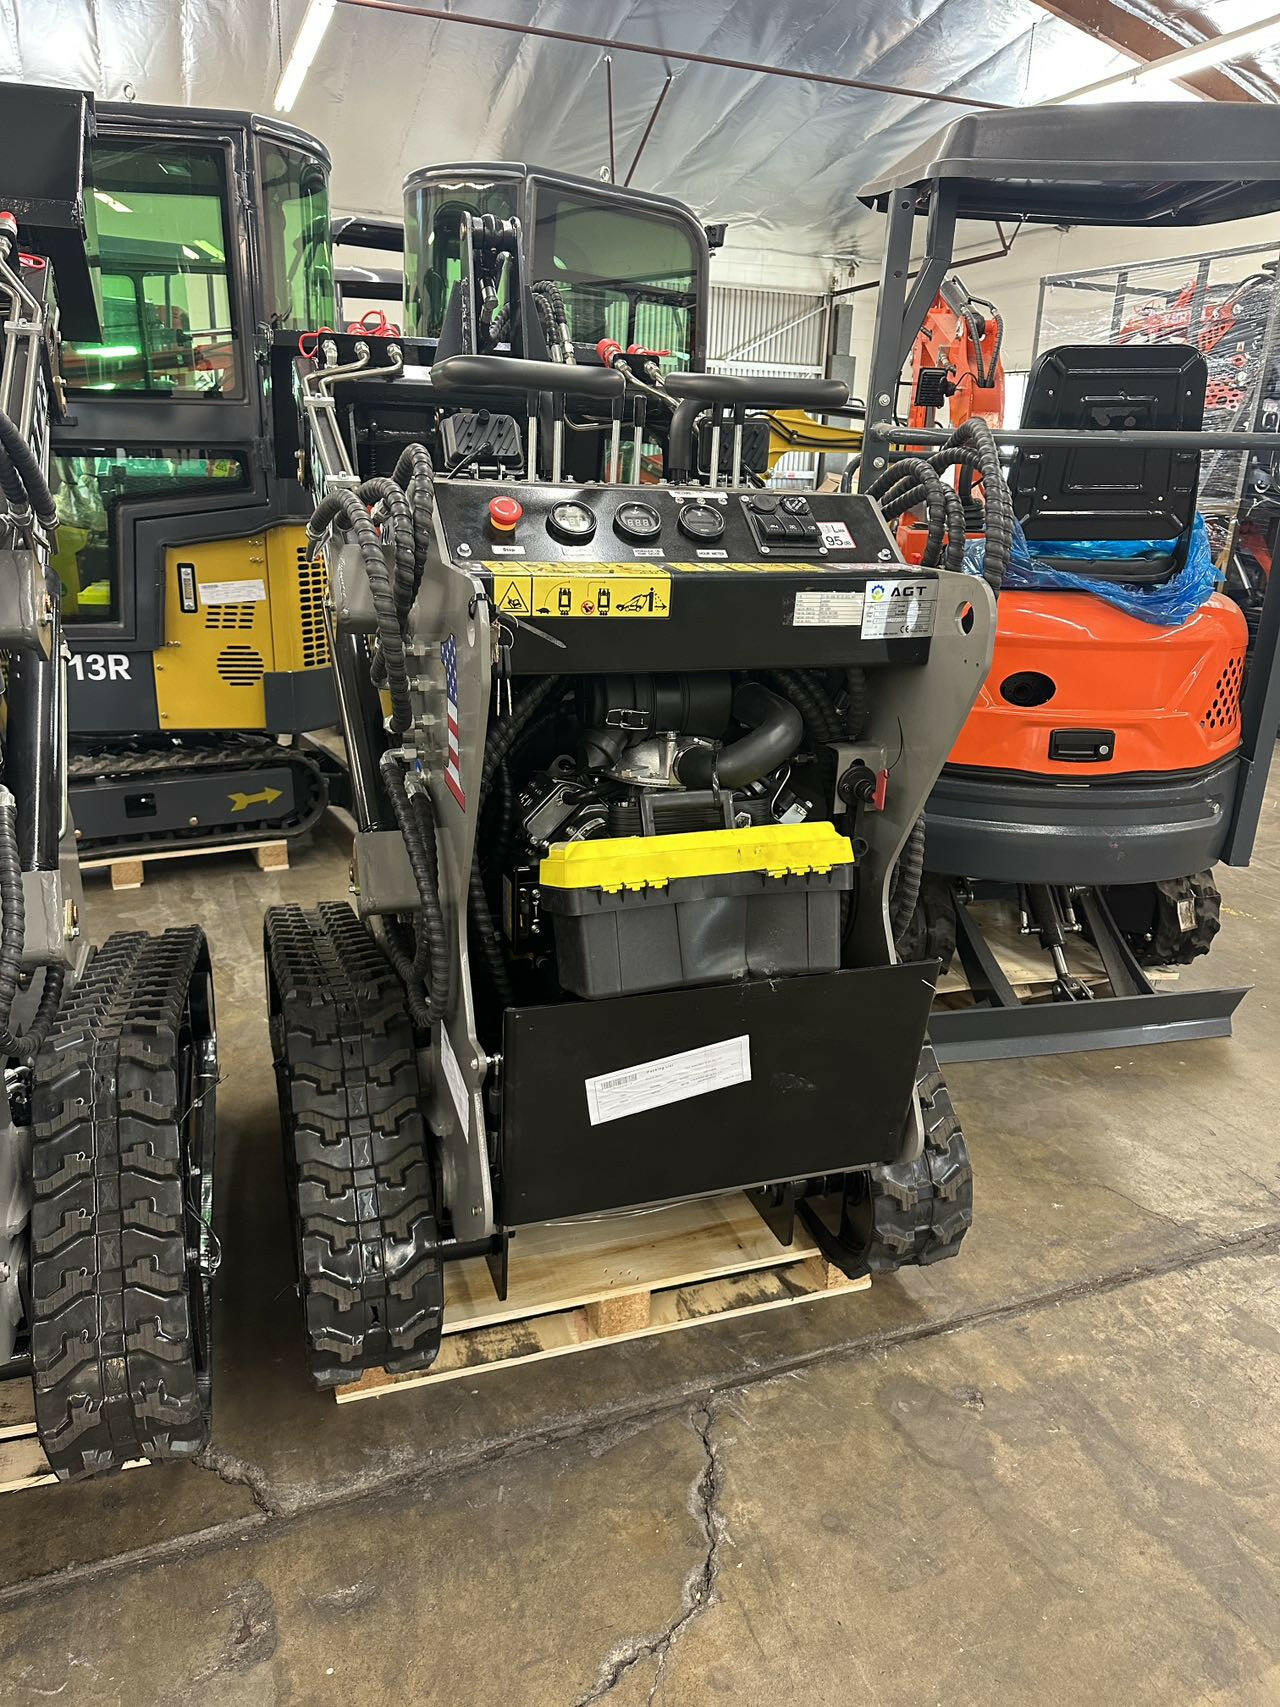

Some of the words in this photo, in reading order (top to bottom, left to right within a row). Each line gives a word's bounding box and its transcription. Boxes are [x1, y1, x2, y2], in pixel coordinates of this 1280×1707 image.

[825, 535, 844, 546] 95
[891, 586, 927, 598] AGT
[68, 653, 132, 681] 13R
